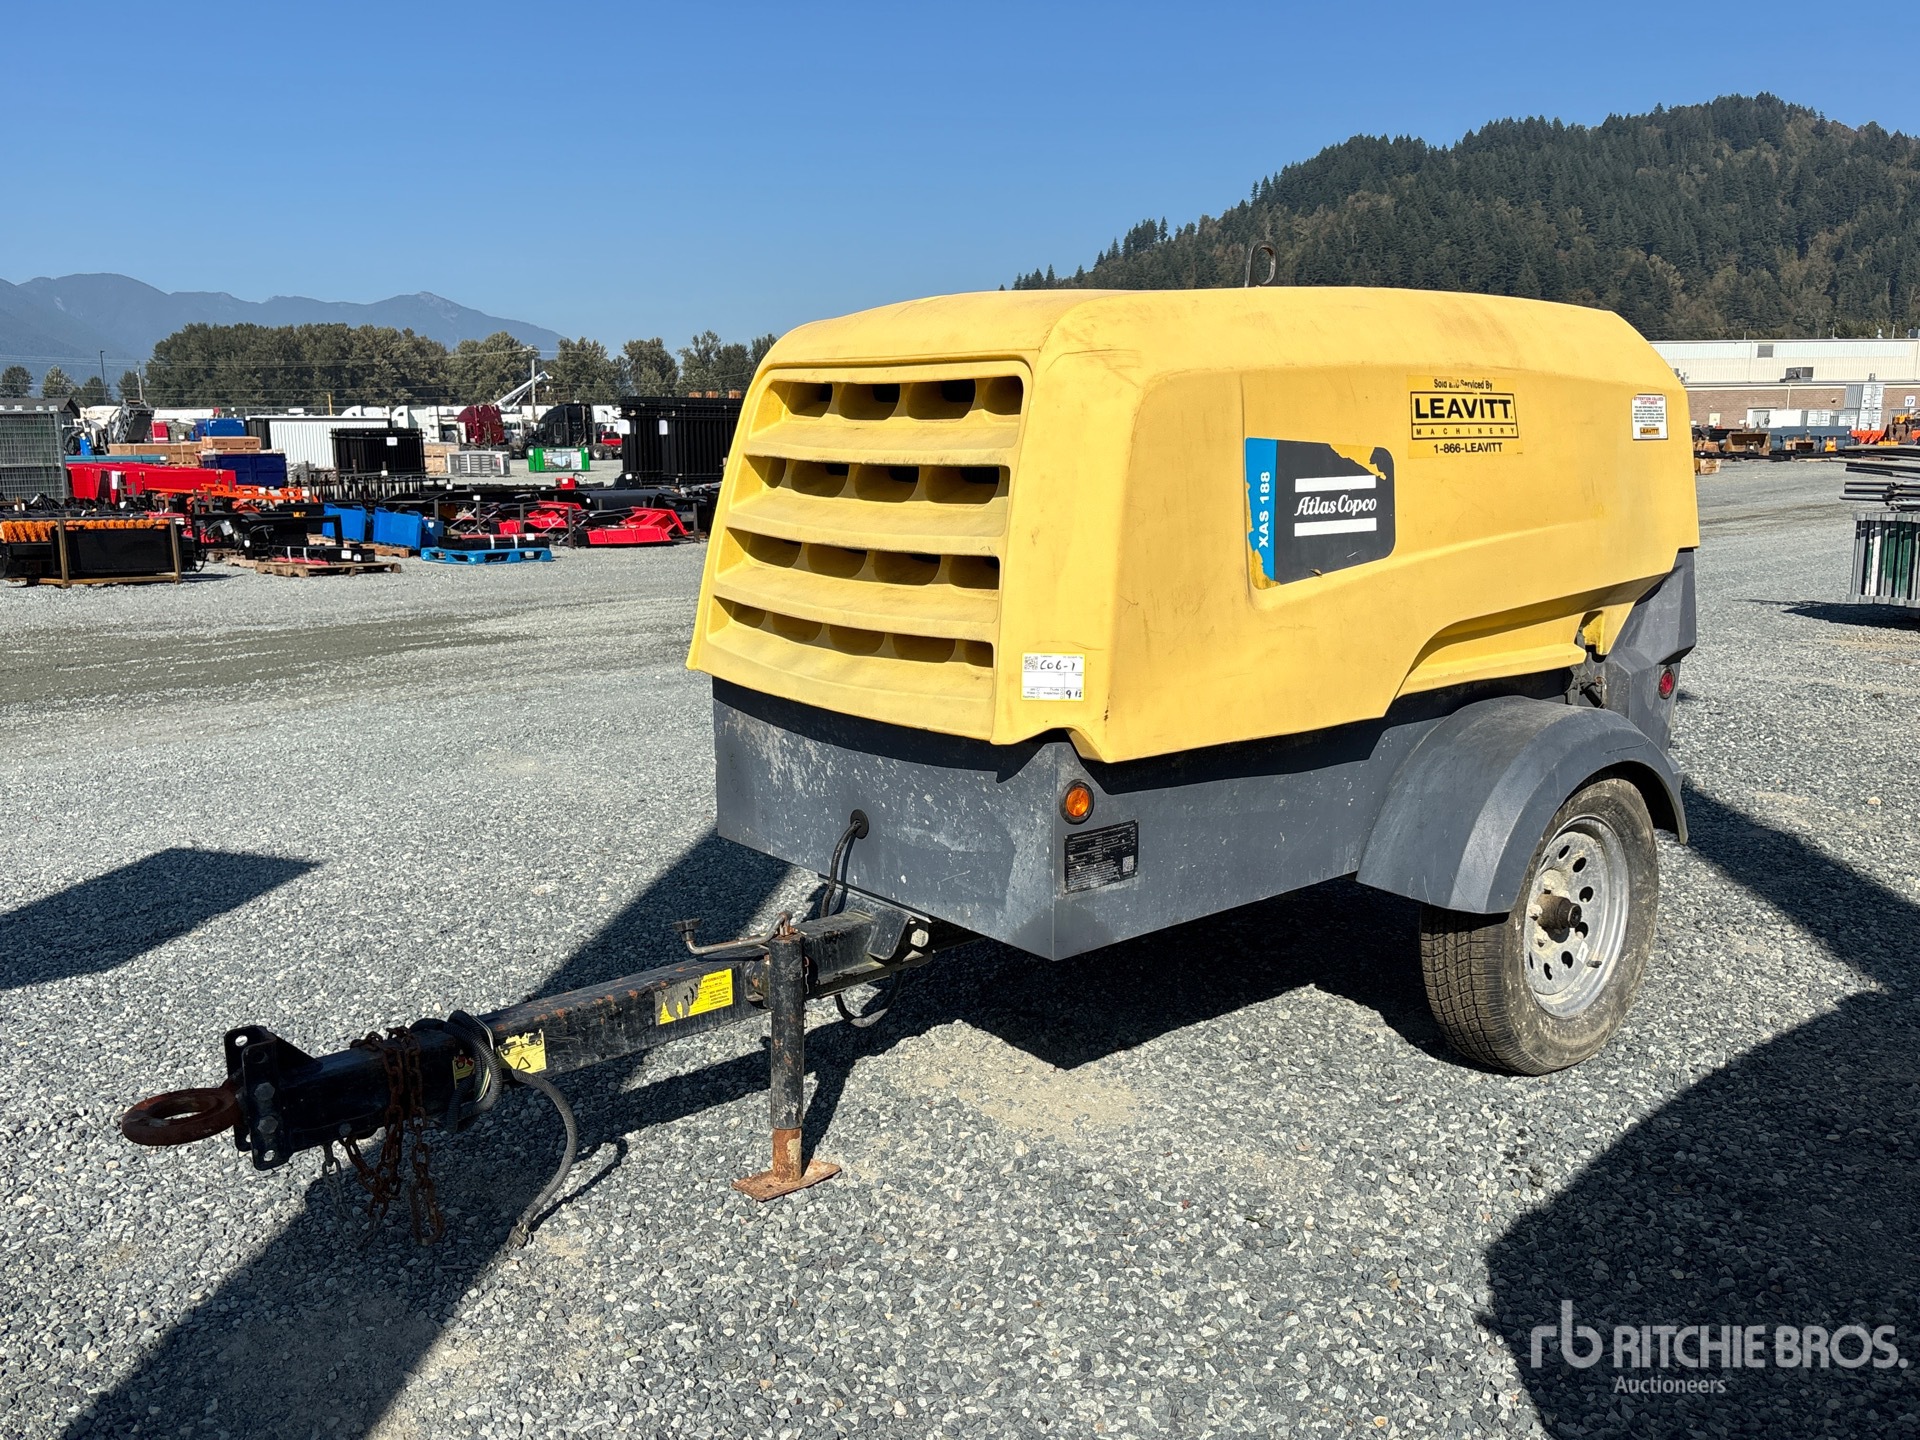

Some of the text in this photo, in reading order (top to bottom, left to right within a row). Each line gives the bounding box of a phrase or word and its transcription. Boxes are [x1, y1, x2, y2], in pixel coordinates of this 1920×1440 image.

[1485, 380, 1493, 391] By
[1434, 442, 1503, 453] 1-866-LEAVITT
[1259, 471, 1271, 548] XAS 188
